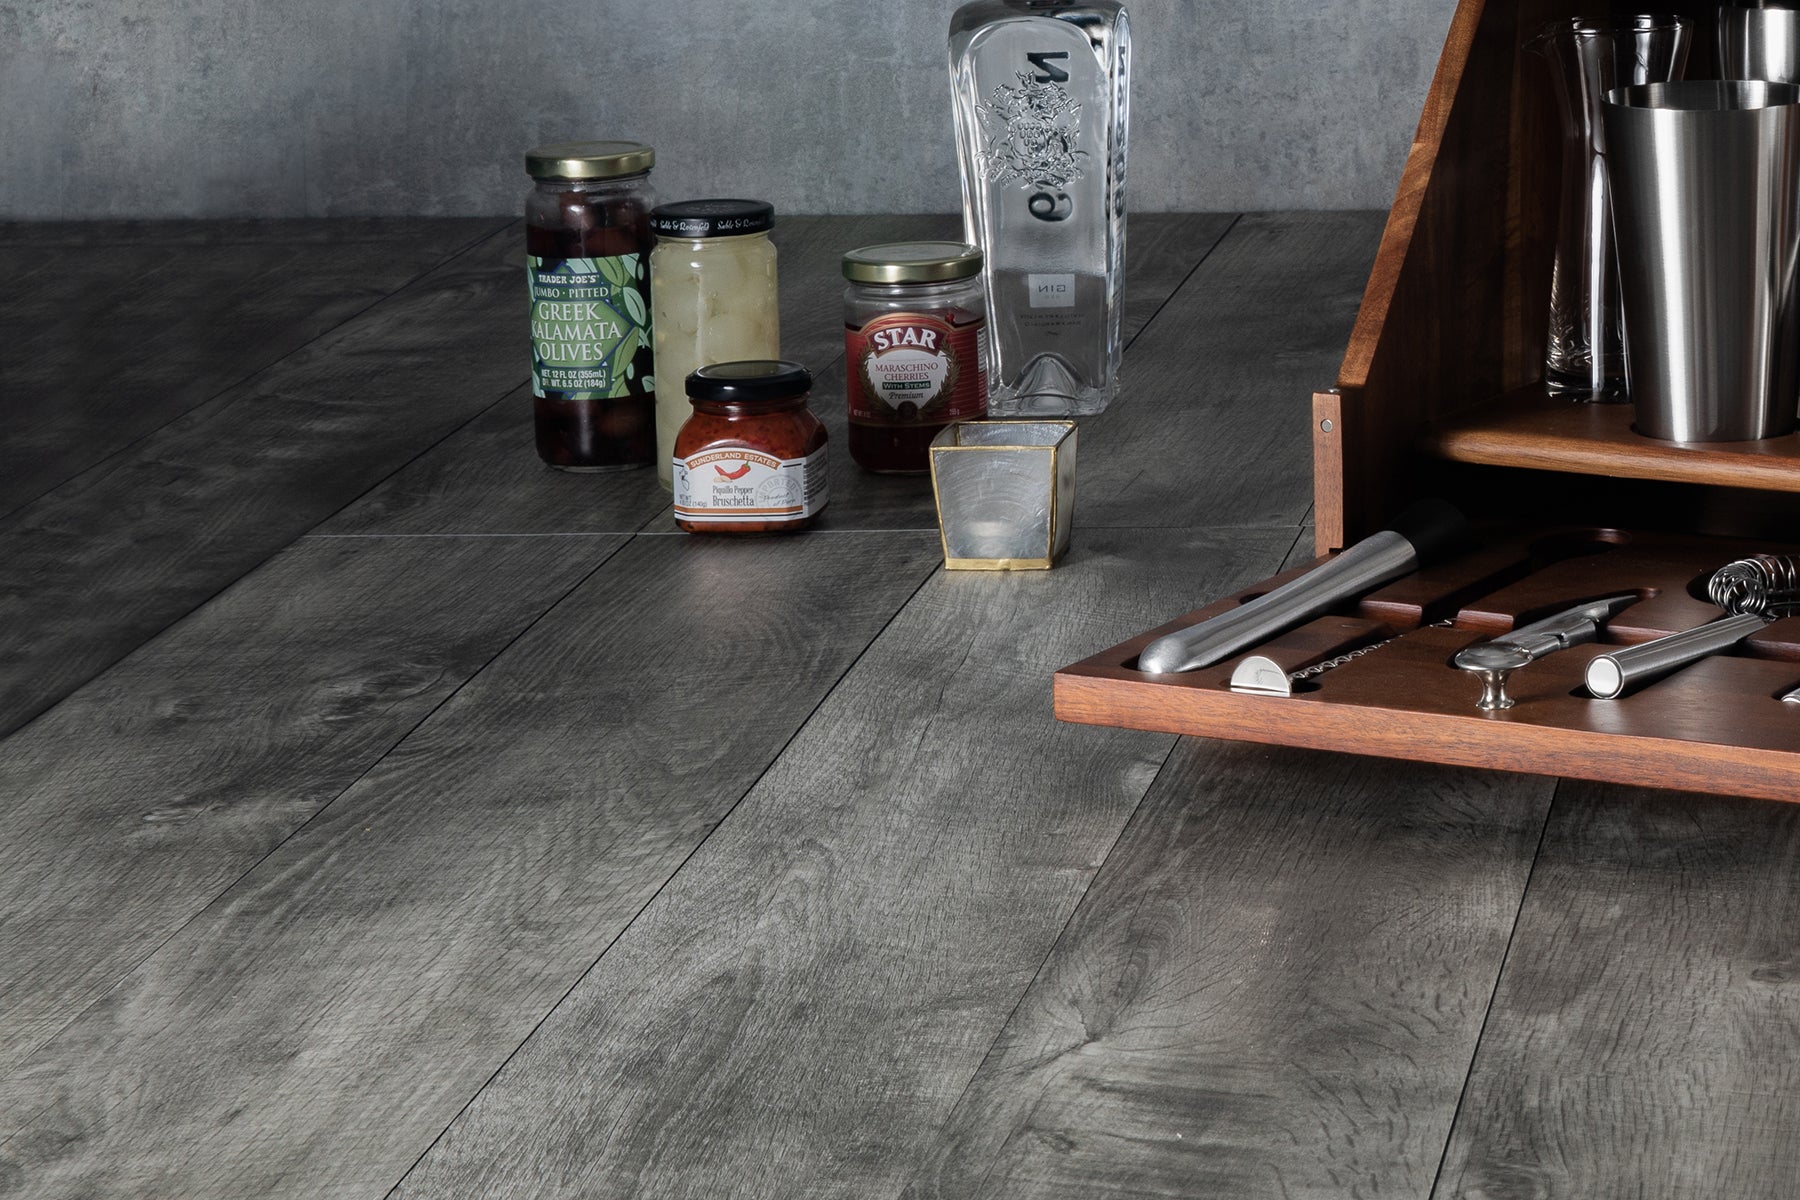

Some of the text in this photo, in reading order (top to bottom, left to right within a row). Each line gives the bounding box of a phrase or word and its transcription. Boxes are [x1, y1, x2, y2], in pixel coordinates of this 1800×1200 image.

[538, 274, 597, 284] TRADER JOE'S
[535, 287, 609, 298] JUMBO PITTED
[538, 302, 601, 321] GREEK
[532, 319, 622, 341] KALAMATA
[874, 327, 936, 350] STAR
[540, 342, 603, 361] OLIVES
[875, 362, 939, 372] MARASCHINO
[884, 372, 929, 381] CHERRIES
[889, 391, 924, 400] Premium
[690, 453, 777, 468] SUNDERLAND ESTATES
[712, 495, 754, 506] Bruschetta
